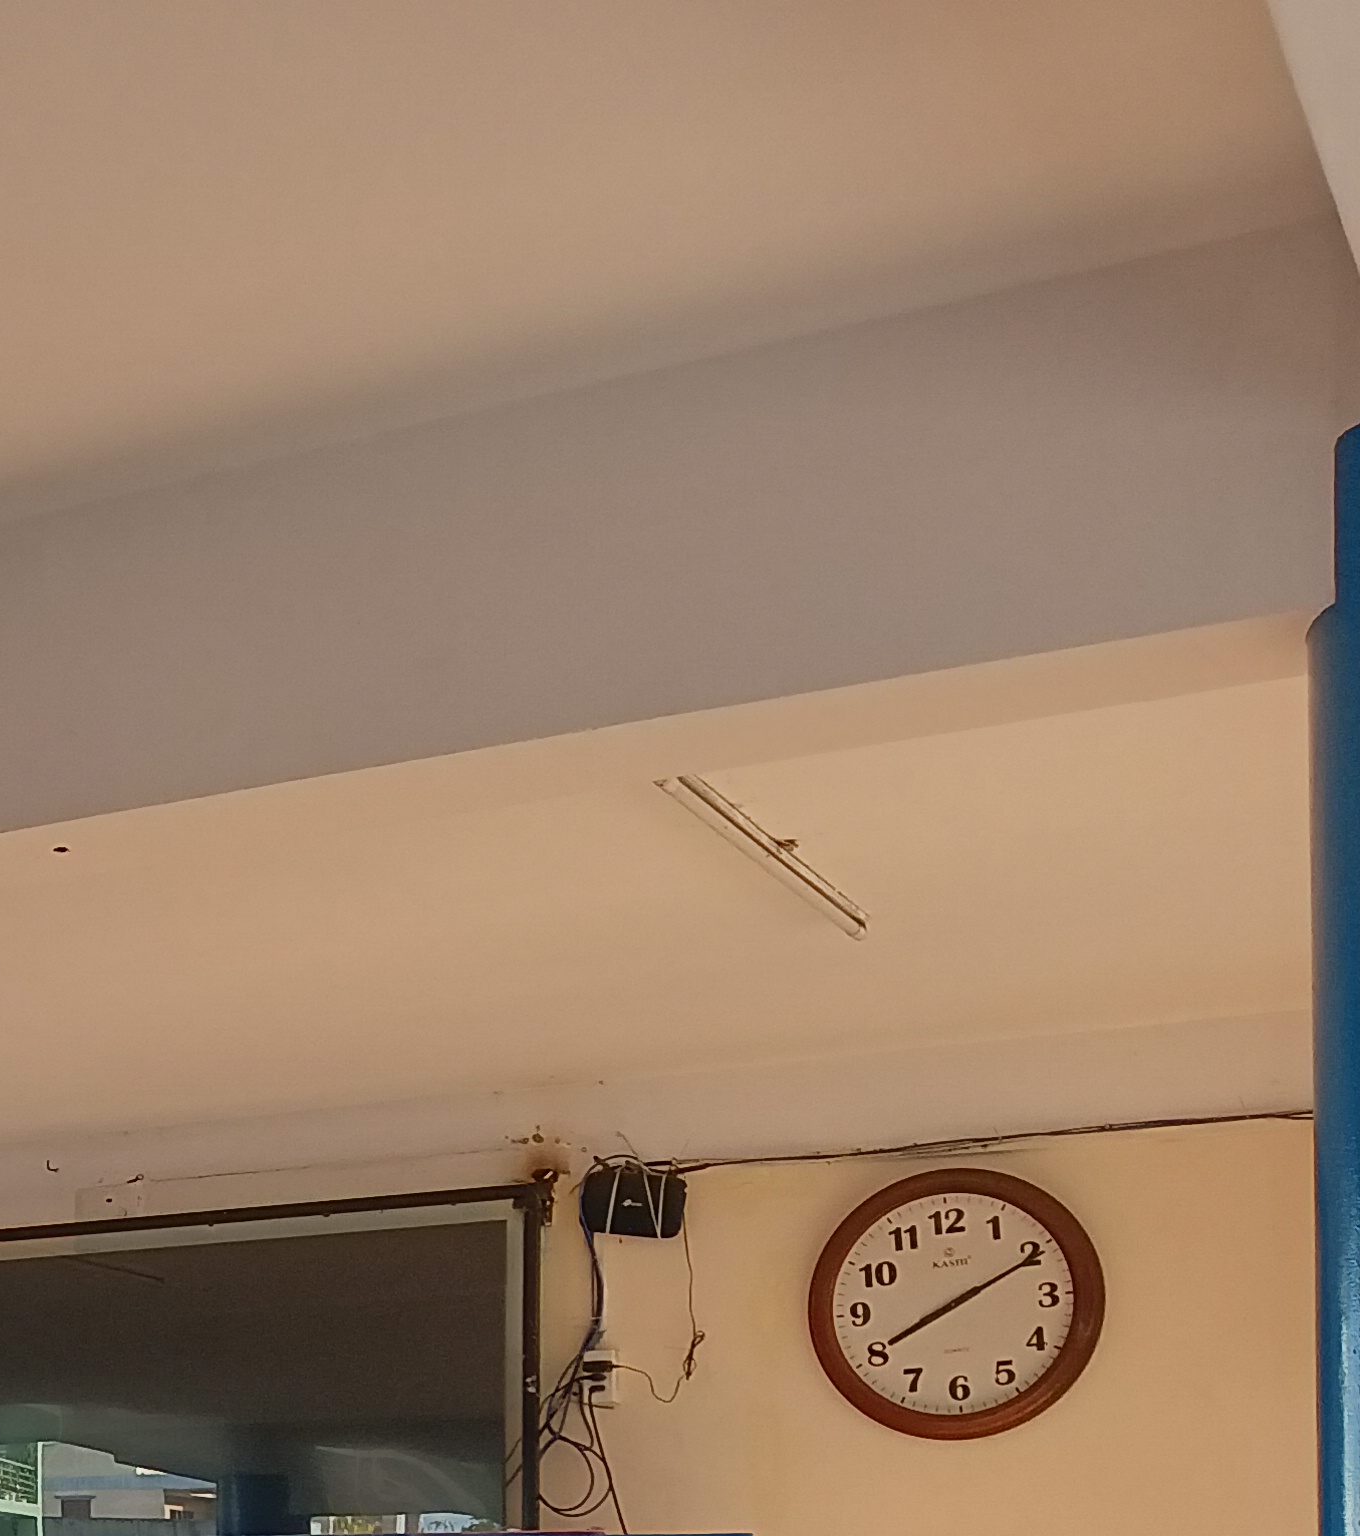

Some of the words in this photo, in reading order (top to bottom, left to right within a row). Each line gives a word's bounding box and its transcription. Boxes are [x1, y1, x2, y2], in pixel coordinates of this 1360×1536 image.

[928, 1208, 966, 1236] 12
[986, 1215, 1002, 1240] 1
[888, 1225, 919, 1251] 11
[1019, 1241, 1043, 1266] 2
[859, 1260, 897, 1288] 10
[1037, 1282, 1060, 1308] 3
[849, 1302, 871, 1327] 9
[1025, 1326, 1048, 1351] 4
[867, 1341, 890, 1367] 8
[903, 1367, 923, 1393] 7
[994, 1359, 1016, 1385] 5
[948, 1375, 971, 1401] 6
